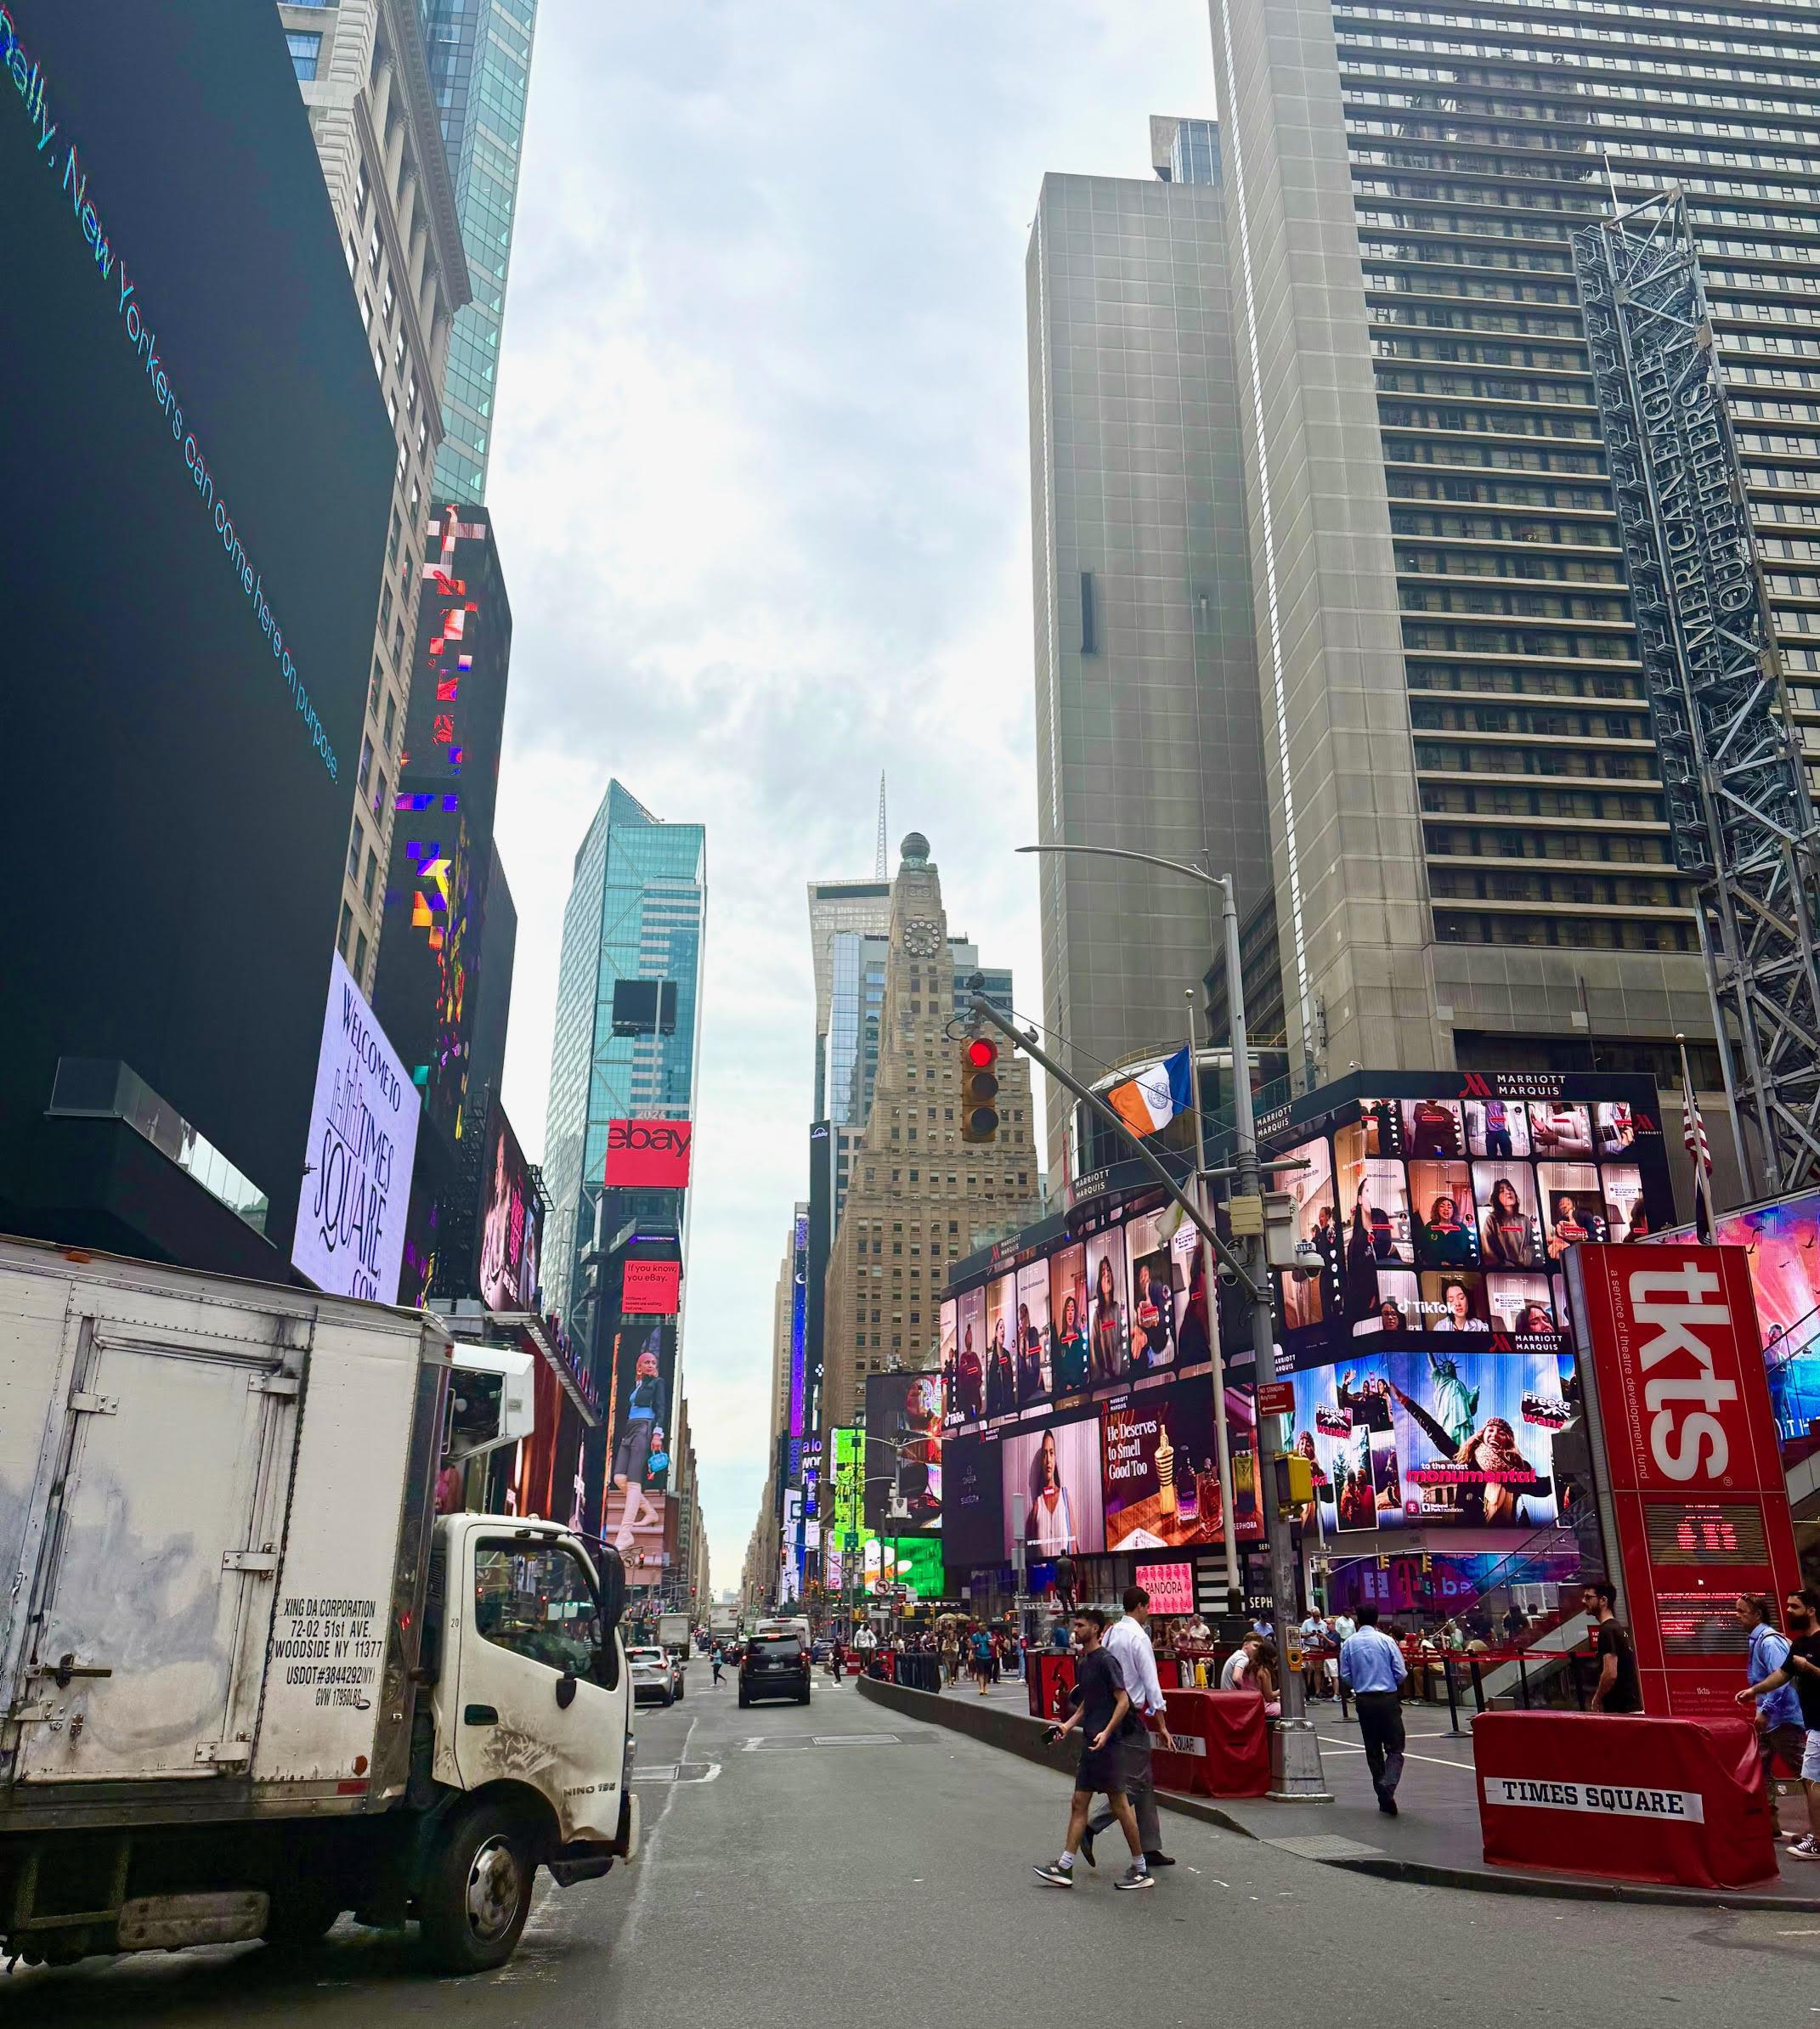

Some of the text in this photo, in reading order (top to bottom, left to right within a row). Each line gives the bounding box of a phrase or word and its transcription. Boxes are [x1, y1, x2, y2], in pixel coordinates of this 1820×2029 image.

[63, 144, 116, 280] New
[119, 260, 183, 440] Yorkers
[184, 434, 213, 509] can
[215, 500, 252, 594] come
[253, 574, 282, 658] here
[282, 650, 297, 693] on
[1681, 382, 1752, 613] OUTFITTERS
[1635, 351, 1723, 679] AMERICAN EAGLE
[342, 982, 402, 1113] WELCOME TO
[1497, 1075, 1566, 1084] MARRIOTT
[1498, 1086, 1560, 1096] MARQUIS
[1257, 1105, 1292, 1128] MARRIOTT
[1258, 1117, 1289, 1139] MARQUIS
[357, 1101, 394, 1194] TIMES
[608, 1120, 691, 1157] ebay
[1075, 1169, 1110, 1190] MARRIOTT
[1076, 1181, 1105, 1201] MARQUIS
[314, 1128, 387, 1279] SQUARE
[644, 1274, 668, 1282] eBay.
[1413, 1301, 1456, 1314] TikTok
[1611, 1280, 1625, 1318] service
[1618, 1321, 1628, 1331] of
[1275, 1354, 1296, 1365] ARRIOTT
[1618, 1335, 1632, 1374] theatre
[1275, 1363, 1294, 1372] ARQUIS
[1629, 1262, 1738, 1482] tkts
[1266, 1385, 1286, 1393] STANDING
[1317, 1402, 1336, 1416] Free
[1523, 1391, 1557, 1408] Free
[1625, 1377, 1645, 1450] development
[1107, 1420, 1157, 1441] He Deserves
[1108, 1438, 1141, 1461] to Smell
[1109, 1460, 1148, 1480] Good Too
[1406, 1468, 1537, 1484] monumental
[1636, 1452, 1650, 1480] fund
[1145, 1581, 1183, 1595] PANDORA
[284, 1598, 376, 1618] XING DA CORPORATION
[1249, 1596, 1274, 1608] SEPH
[291, 1620, 371, 1638] 72-02 51st AVE.
[450, 1618, 460, 1628] 20
[275, 1641, 382, 1658] WOODSIDE NY 11377
[315, 1688, 331, 1707] GVW
[563, 1786, 595, 1797] HINO
[1502, 1781, 1685, 1815] TIMES SQUARE
